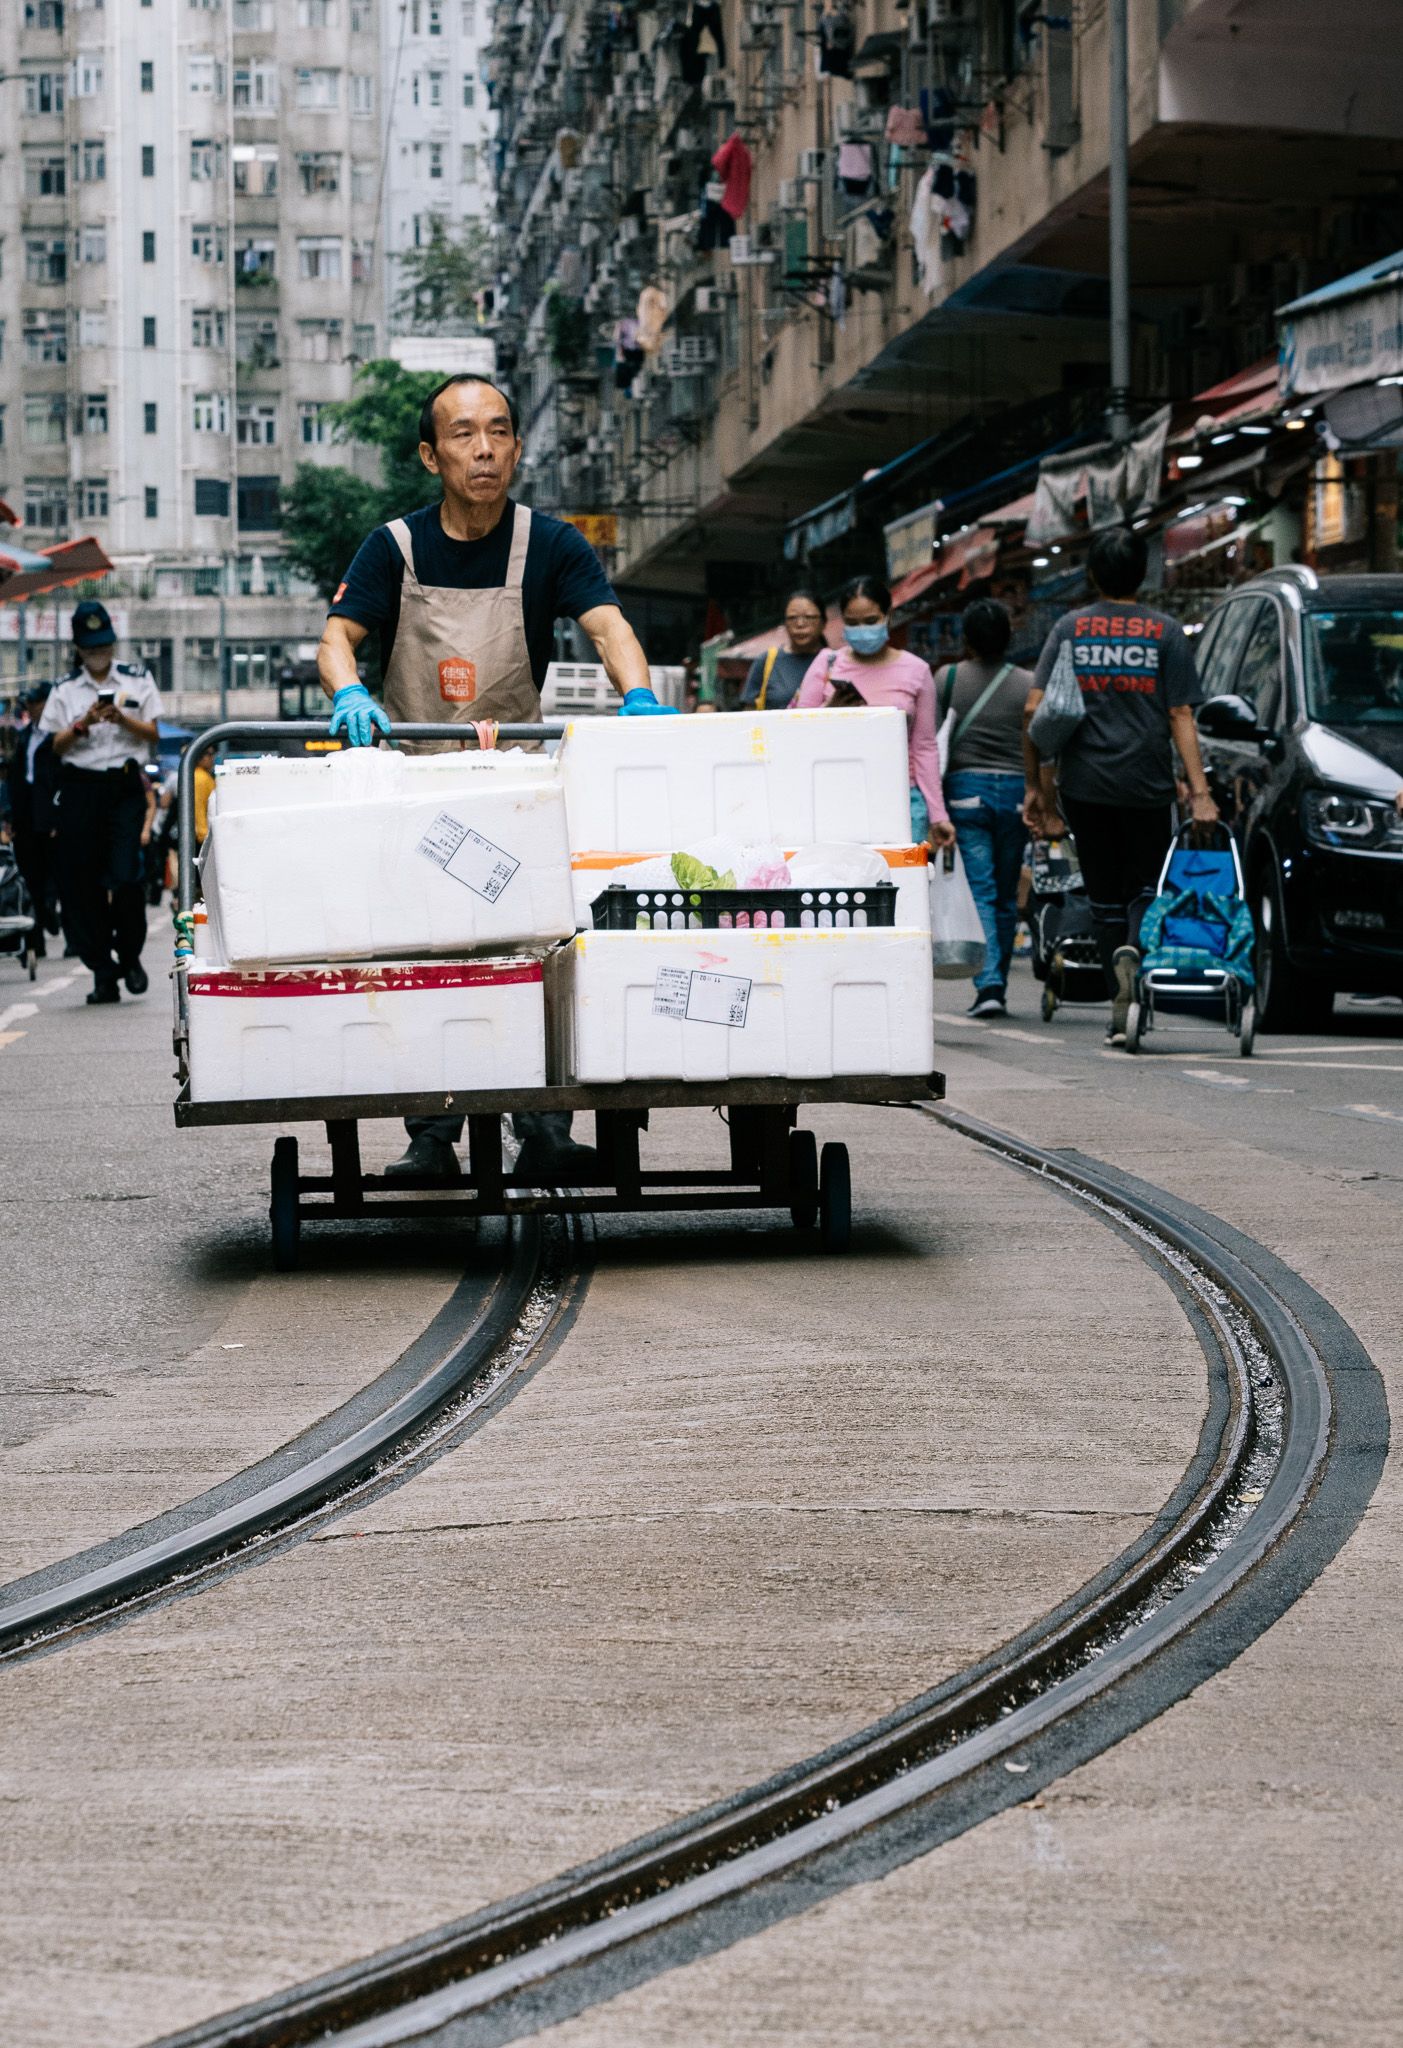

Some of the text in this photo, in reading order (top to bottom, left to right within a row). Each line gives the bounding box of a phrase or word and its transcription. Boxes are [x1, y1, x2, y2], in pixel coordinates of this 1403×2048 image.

[1075, 616, 1164, 639] FRESH
[1074, 645, 1159, 669] SINCE
[444, 684, 469, 697] 食品
[1113, 675, 1156, 695] ONE
